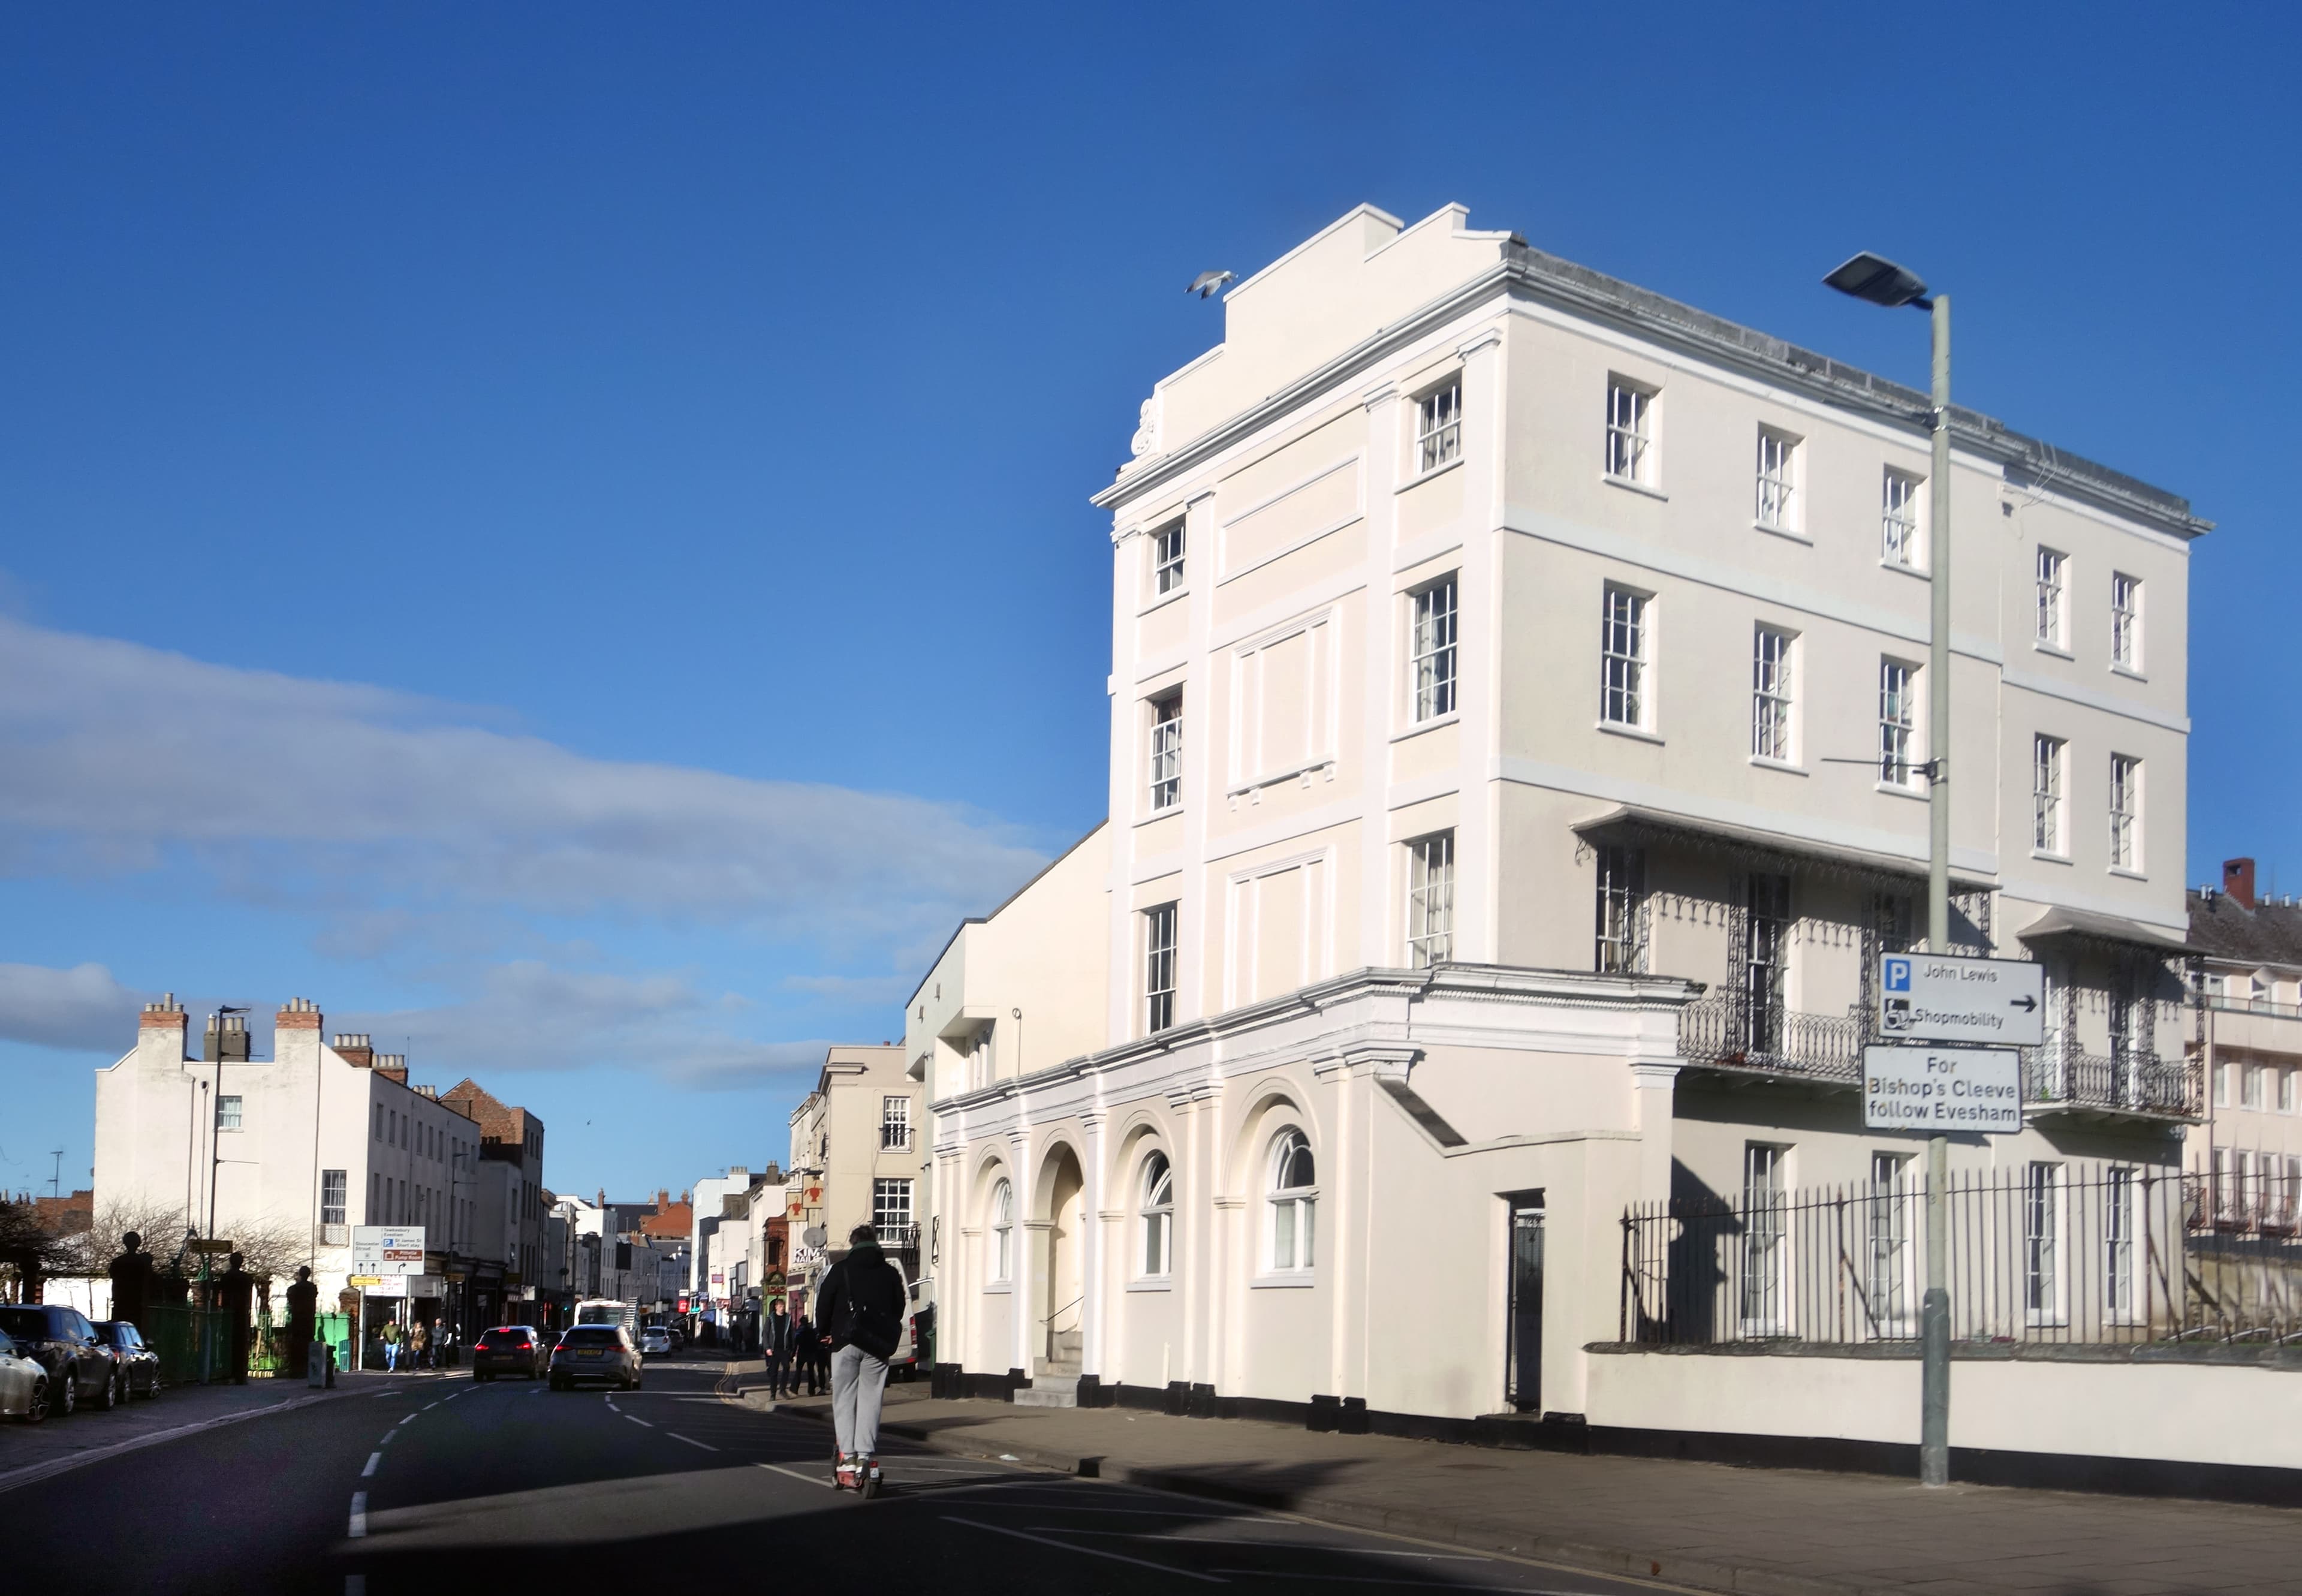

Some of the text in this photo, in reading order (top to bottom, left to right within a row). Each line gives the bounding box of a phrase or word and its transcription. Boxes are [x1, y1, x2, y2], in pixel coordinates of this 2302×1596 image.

[1890, 962, 1908, 989] P
[1923, 964, 1998, 983] John Lewis
[1915, 1008, 2004, 1029] Shopmobility
[1927, 1057, 1957, 1074] For
[1869, 1077, 2015, 1098] Bishop's Cleeve
[1869, 1101, 2016, 1122] follow Evesham
